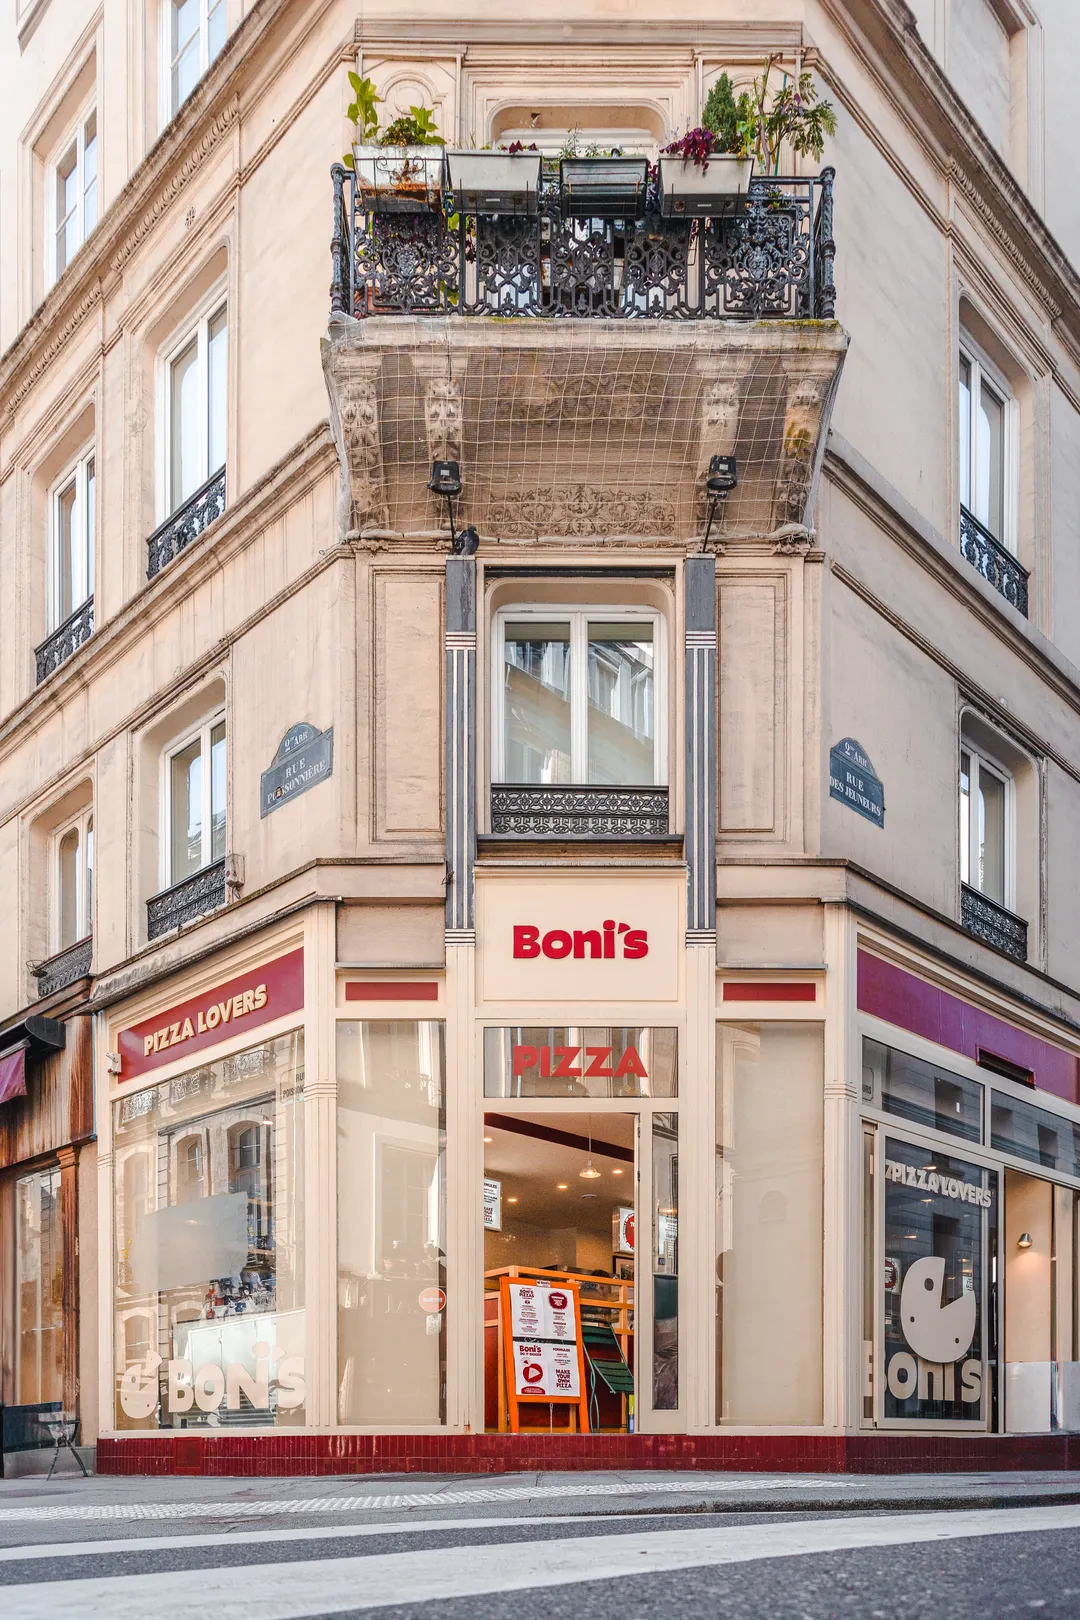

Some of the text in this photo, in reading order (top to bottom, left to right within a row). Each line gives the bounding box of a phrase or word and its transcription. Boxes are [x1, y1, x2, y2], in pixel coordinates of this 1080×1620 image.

[267, 759, 326, 804] POSSONNIÈRE
[285, 757, 306, 779] RUE
[846, 771, 864, 792] RUE
[829, 777, 881, 817] DES JEUNEURS
[513, 919, 649, 960] Boni's
[143, 983, 268, 1057] PIZZA LOVERS
[513, 1045, 649, 1078] PIZZA
[891, 1162, 992, 1208] PIZZA LOVERS
[519, 1345, 541, 1353] Boni's
